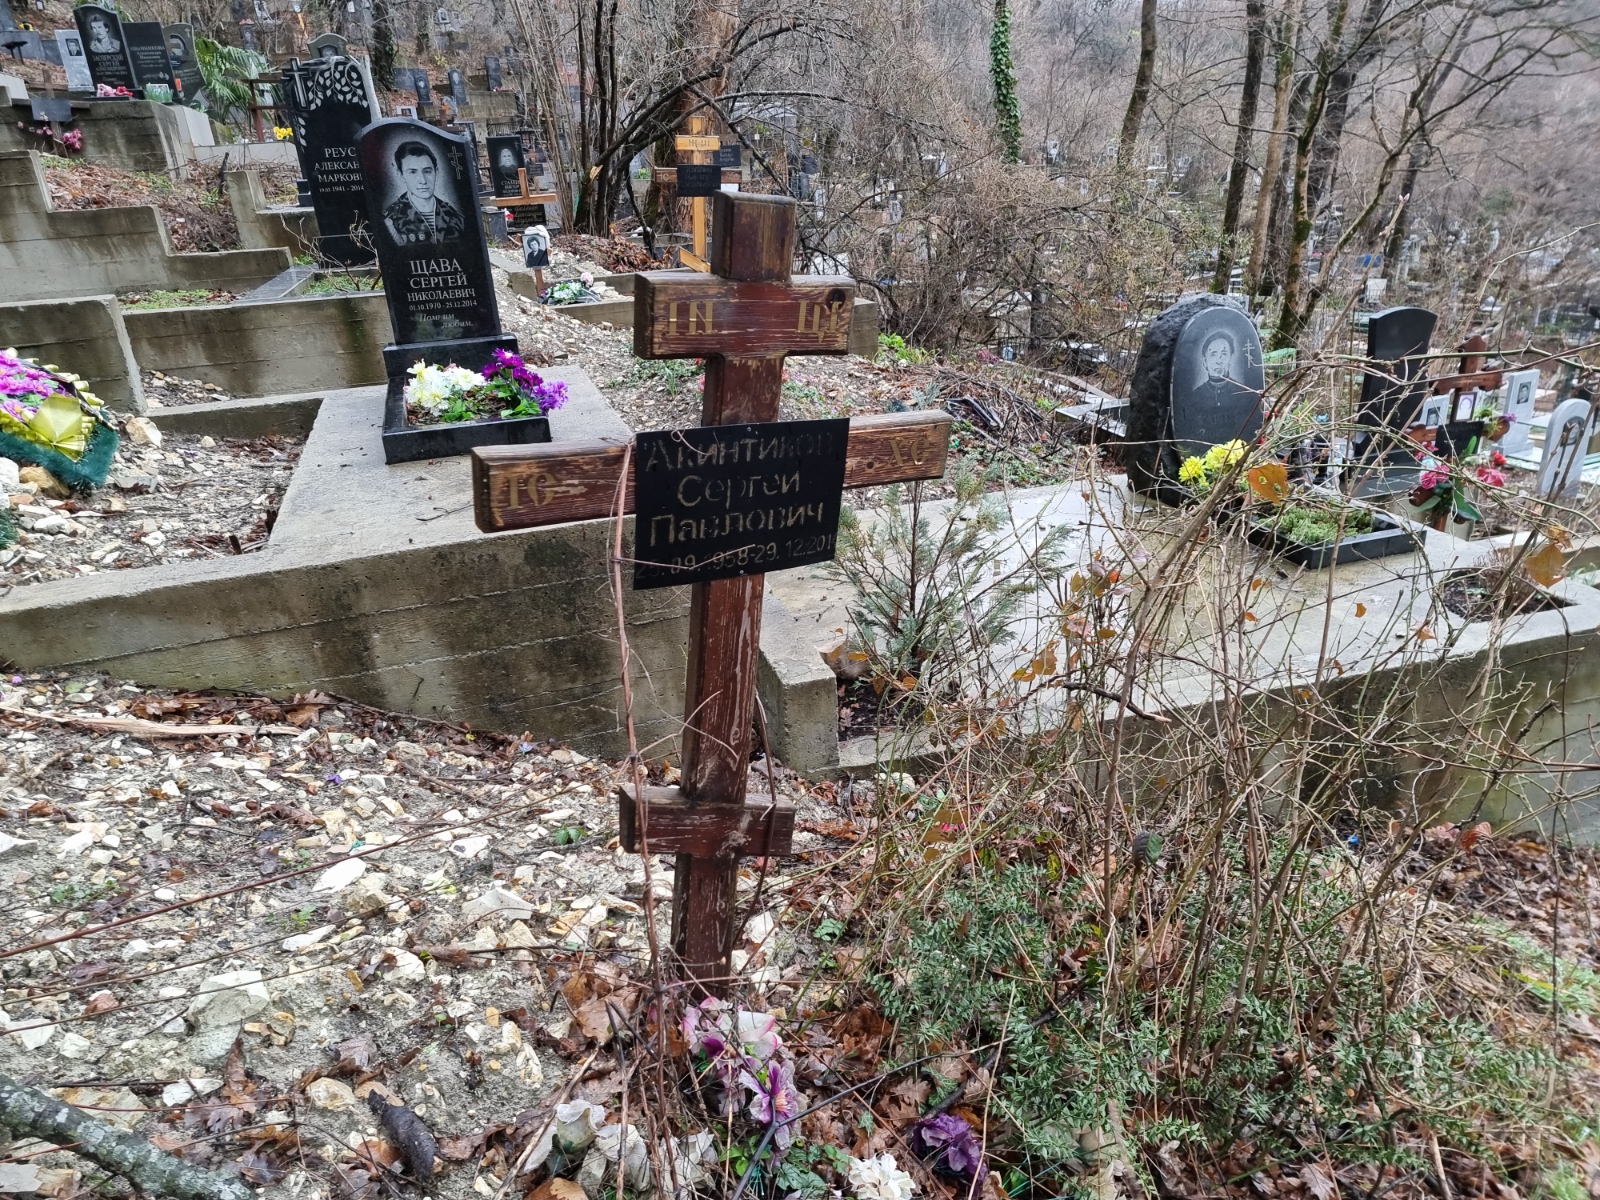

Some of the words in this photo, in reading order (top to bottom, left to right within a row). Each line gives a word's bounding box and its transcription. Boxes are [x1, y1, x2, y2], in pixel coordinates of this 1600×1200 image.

[324, 147, 356, 157] РЕУС
[409, 258, 463, 276] ЩАВА
[410, 272, 468, 289] СЕРГЕЙ
[407, 288, 475, 301] НИКОЛАЕВИЧ
[650, 502, 824, 547] Павлович
